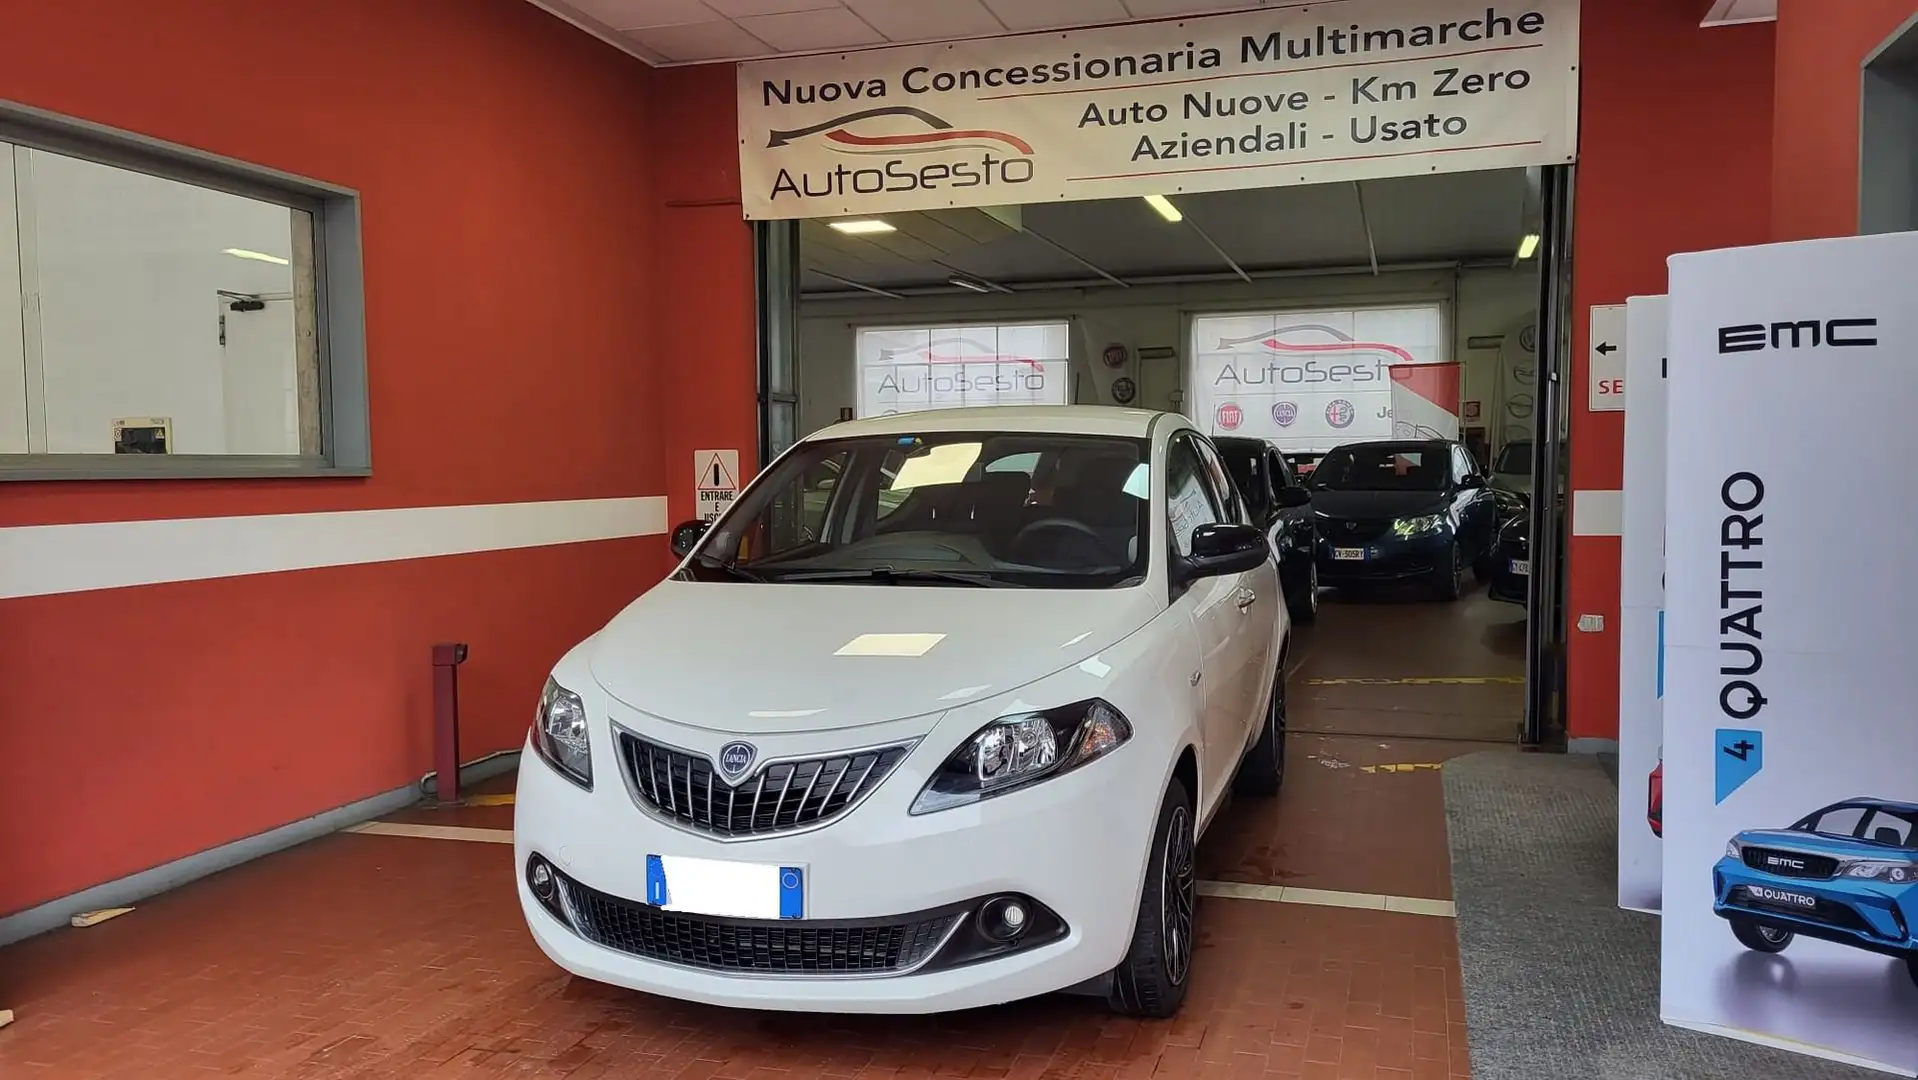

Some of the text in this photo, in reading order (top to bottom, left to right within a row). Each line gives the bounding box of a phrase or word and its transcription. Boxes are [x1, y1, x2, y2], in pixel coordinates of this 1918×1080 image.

[762, 7, 1545, 106] Nuova Concessionaria Multimarche
[1078, 101, 1168, 128] Auto
[1183, 86, 1309, 120] Nuove
[1352, 76, 1416, 105] Km
[1433, 67, 1531, 98] Zero
[1130, 122, 1307, 162] Aziendali
[1350, 112, 1468, 145] Usato
[769, 153, 1035, 201] AutoSesto
[1718, 318, 1878, 354] EMC
[877, 370, 1045, 394] AutoSesto
[701, 490, 733, 501] ENTRARE
[715, 502, 720, 512] E
[704, 512, 721, 523] USC
[1719, 471, 1768, 720] QUATTRO
[725, 754, 746, 764] LANCIA
[1723, 739, 1755, 762] 4
[1767, 856, 1804, 869] EMC
[1764, 889, 1815, 906] QUATTRO
